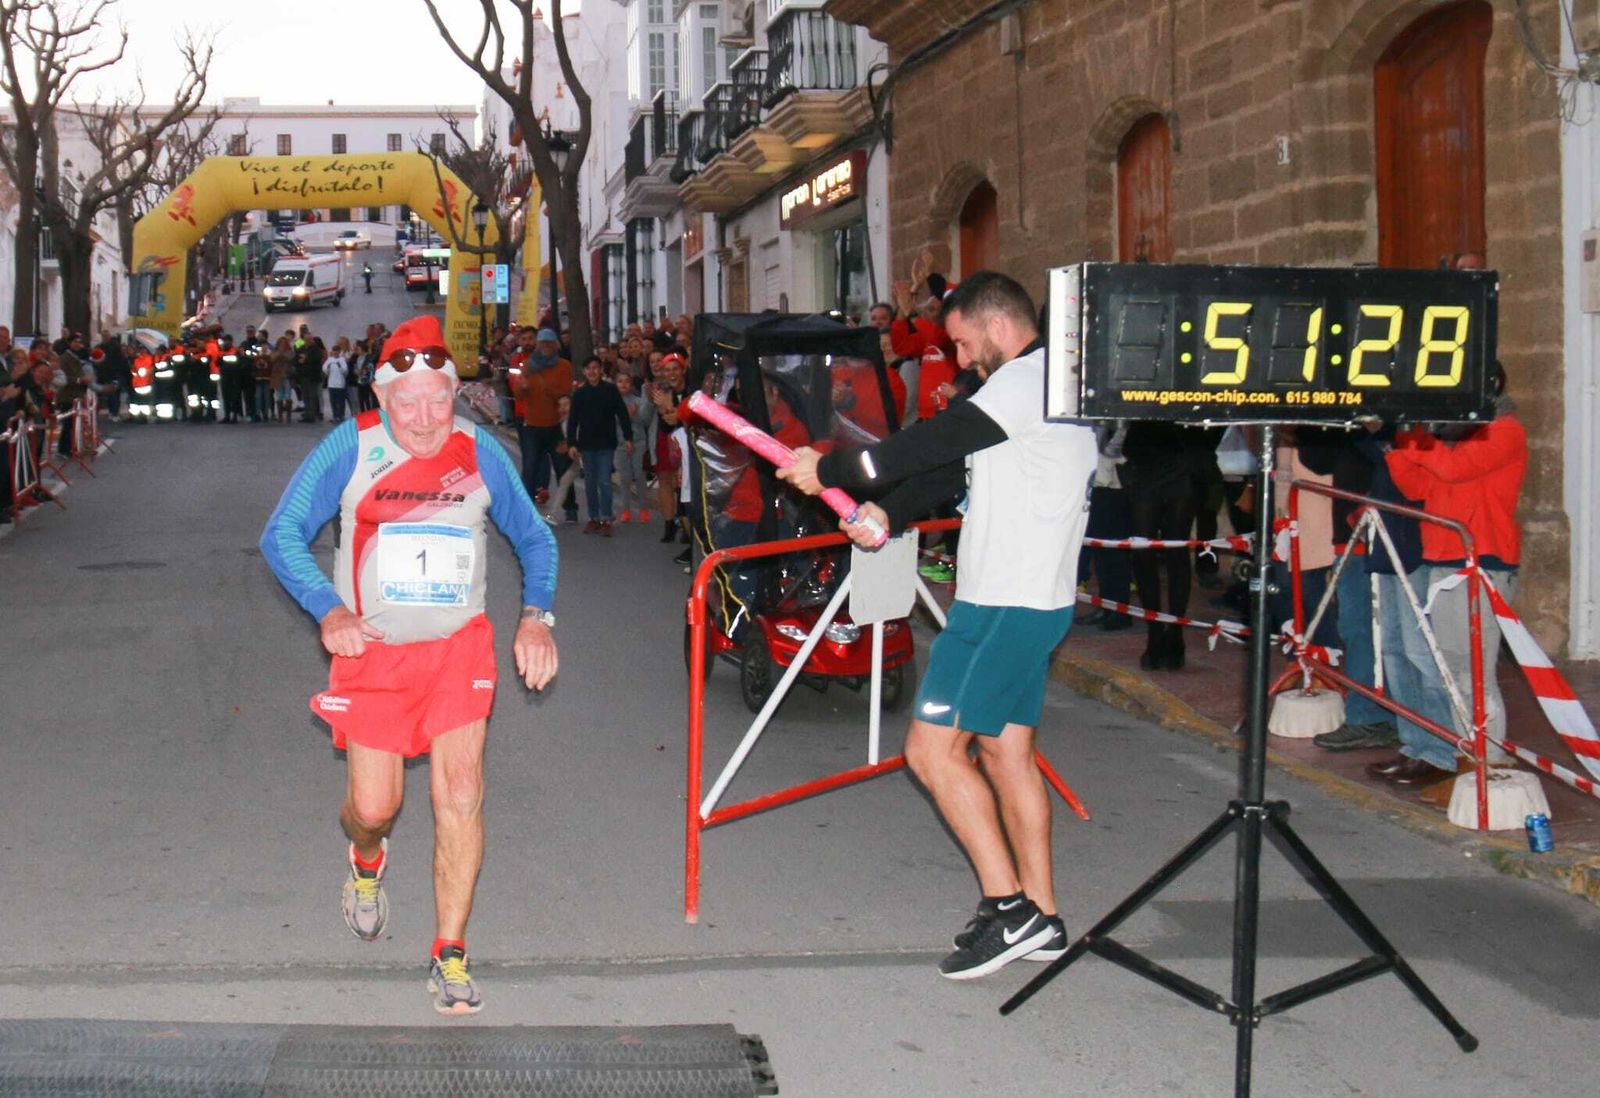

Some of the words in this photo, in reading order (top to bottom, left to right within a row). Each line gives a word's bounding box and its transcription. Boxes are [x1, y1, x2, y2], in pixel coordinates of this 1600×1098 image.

[240, 160, 281, 174] Vive
[291, 160, 311, 173] el
[323, 159, 395, 176] deporte
[1286, 391, 1310, 403] 615
[1312, 392, 1337, 404] 980
[1339, 392, 1362, 404] 784
[374, 488, 466, 503] Vanessa
[416, 549, 427, 576] 1
[381, 581, 467, 602] CHICLANA
